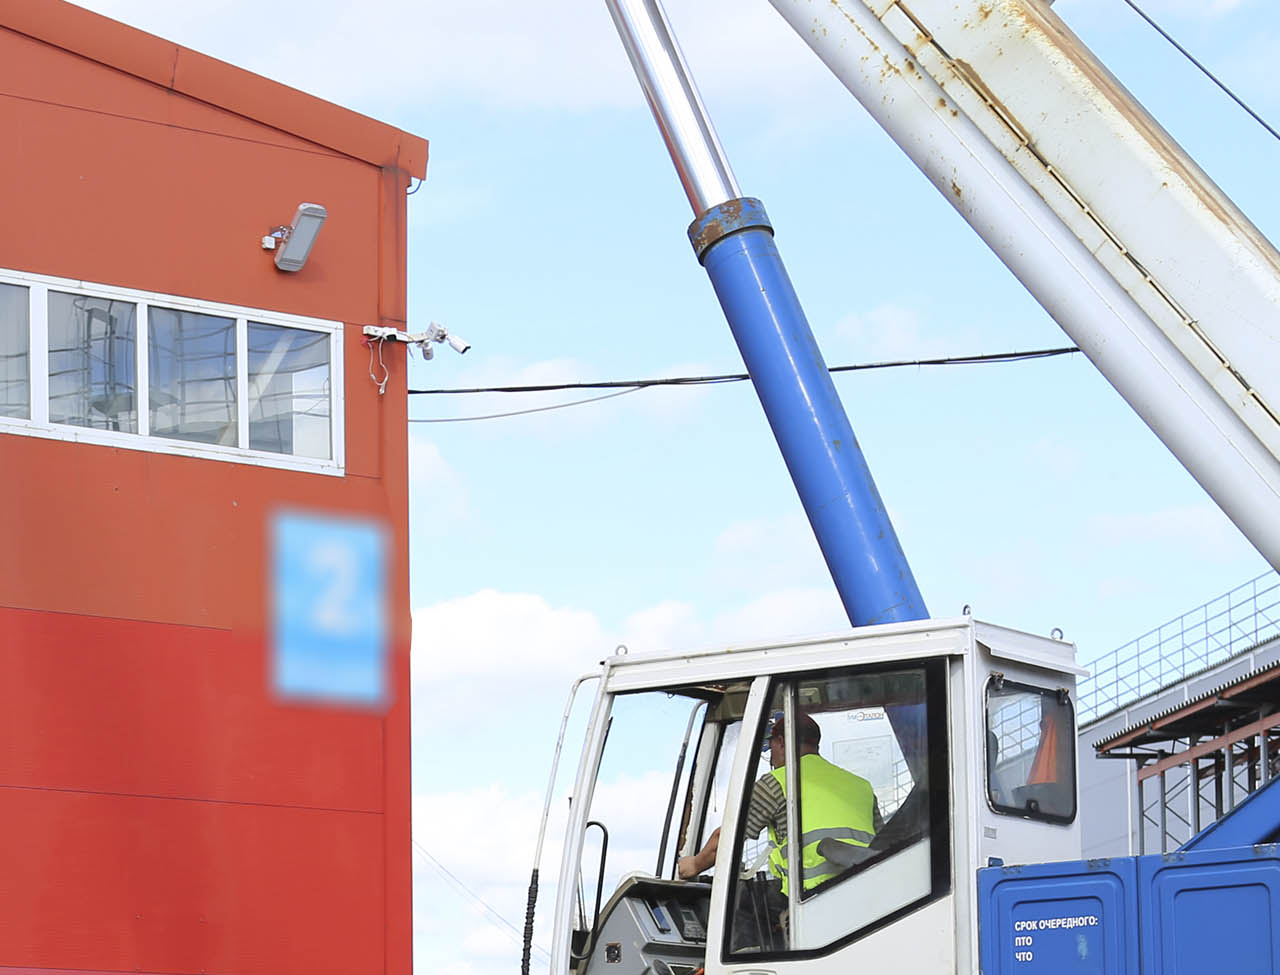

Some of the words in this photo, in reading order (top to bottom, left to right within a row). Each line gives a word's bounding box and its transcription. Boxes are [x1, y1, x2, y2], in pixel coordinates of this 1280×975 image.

[1014, 920, 1038, 931] СРОК
[1038, 915, 1099, 930] ОЧЕРЕДНОГО:
[1014, 936, 1033, 947] ПТО
[1015, 951, 1033, 962] ЧТО
